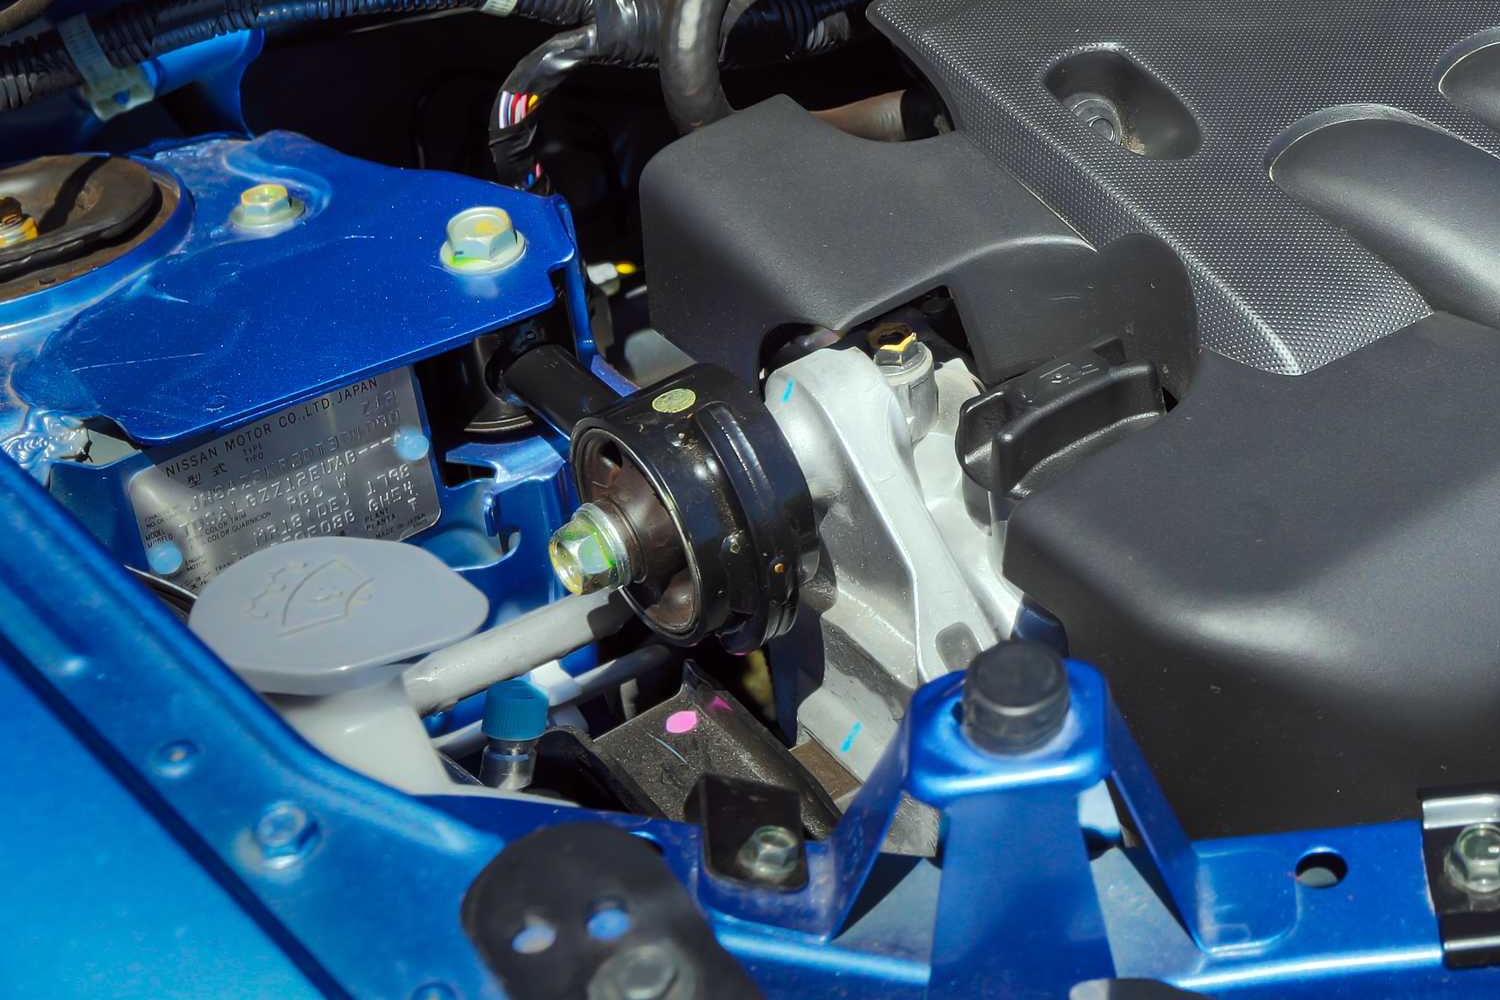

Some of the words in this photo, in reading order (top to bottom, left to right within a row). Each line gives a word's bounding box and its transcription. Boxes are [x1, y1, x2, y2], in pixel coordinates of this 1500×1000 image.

[165, 446, 218, 478] NISSAN
[224, 422, 272, 453] MOTOR
[337, 376, 378, 402] JAPAN
[205, 519, 228, 536] COLOR
[207, 527, 230, 543] COLOR
